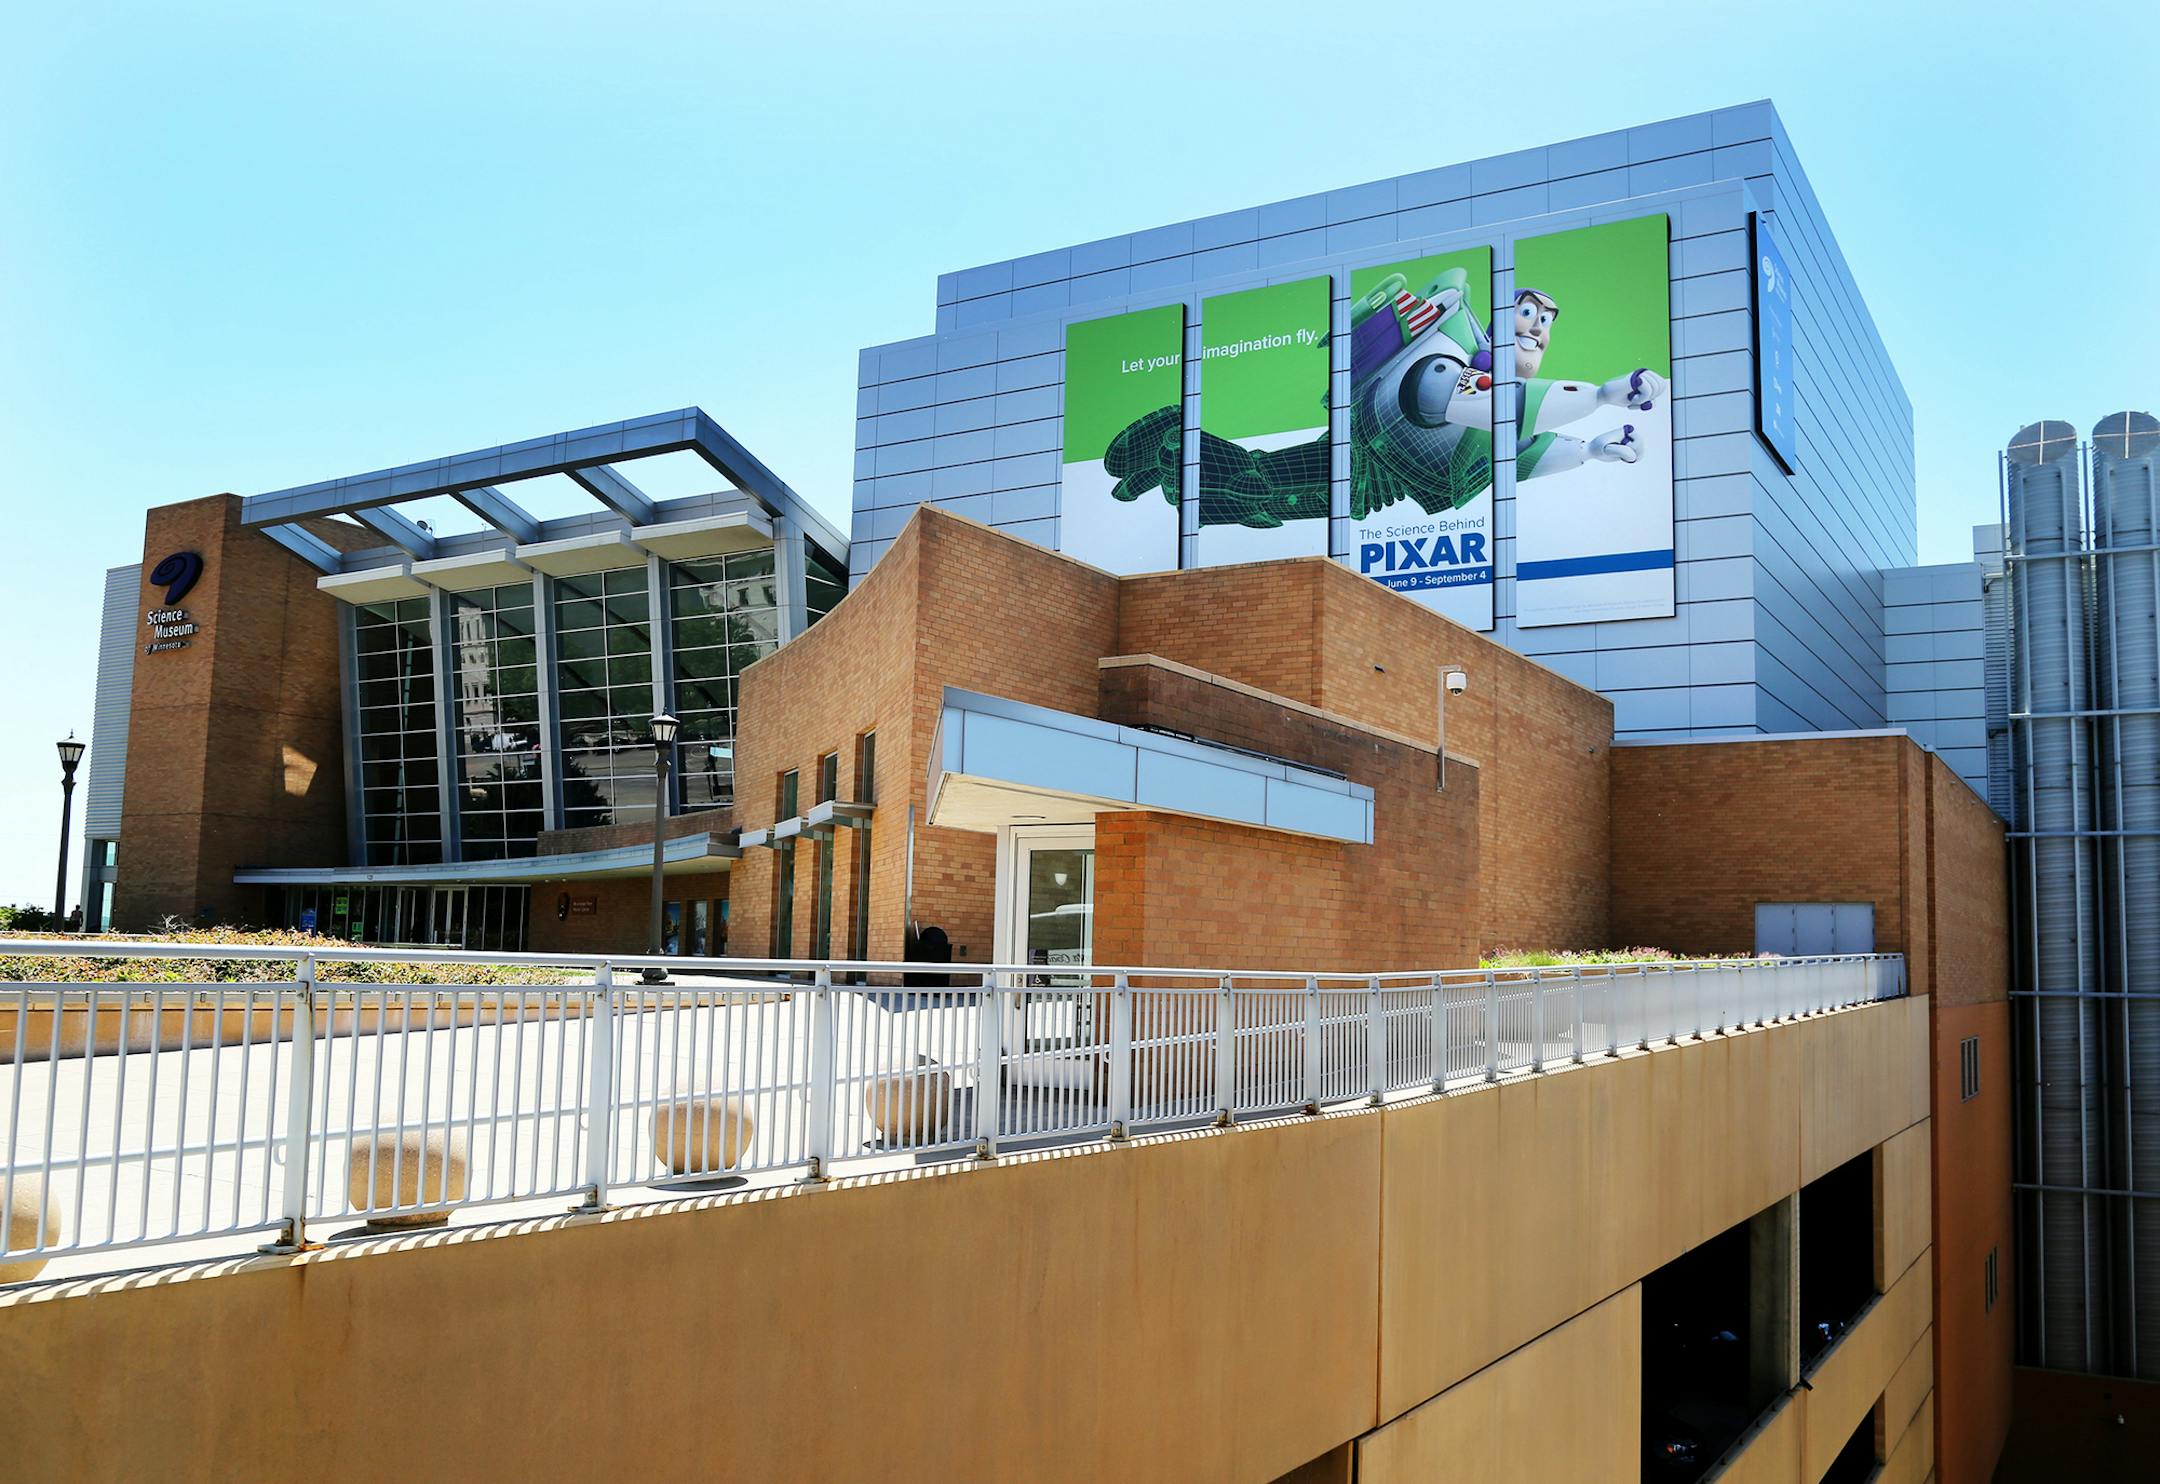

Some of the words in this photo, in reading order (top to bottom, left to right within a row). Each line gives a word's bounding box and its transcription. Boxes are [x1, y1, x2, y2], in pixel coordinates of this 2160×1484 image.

[1121, 358, 1144, 374] Let
[1147, 353, 1181, 373] your
[1202, 333, 1292, 359] imagination
[1296, 328, 1319, 346] fly.
[1359, 528, 1382, 540] The
[1386, 523, 1435, 538] Science
[1439, 516, 1485, 532] Behind
[1361, 533, 1487, 573] PIXAR
[1387, 578, 1408, 588] June
[1411, 577, 1417, 586] 9
[1424, 572, 1478, 586] September
[1480, 570, 1487, 579] 4
[147, 609, 182, 625] Science
[154, 624, 193, 638] Museum
